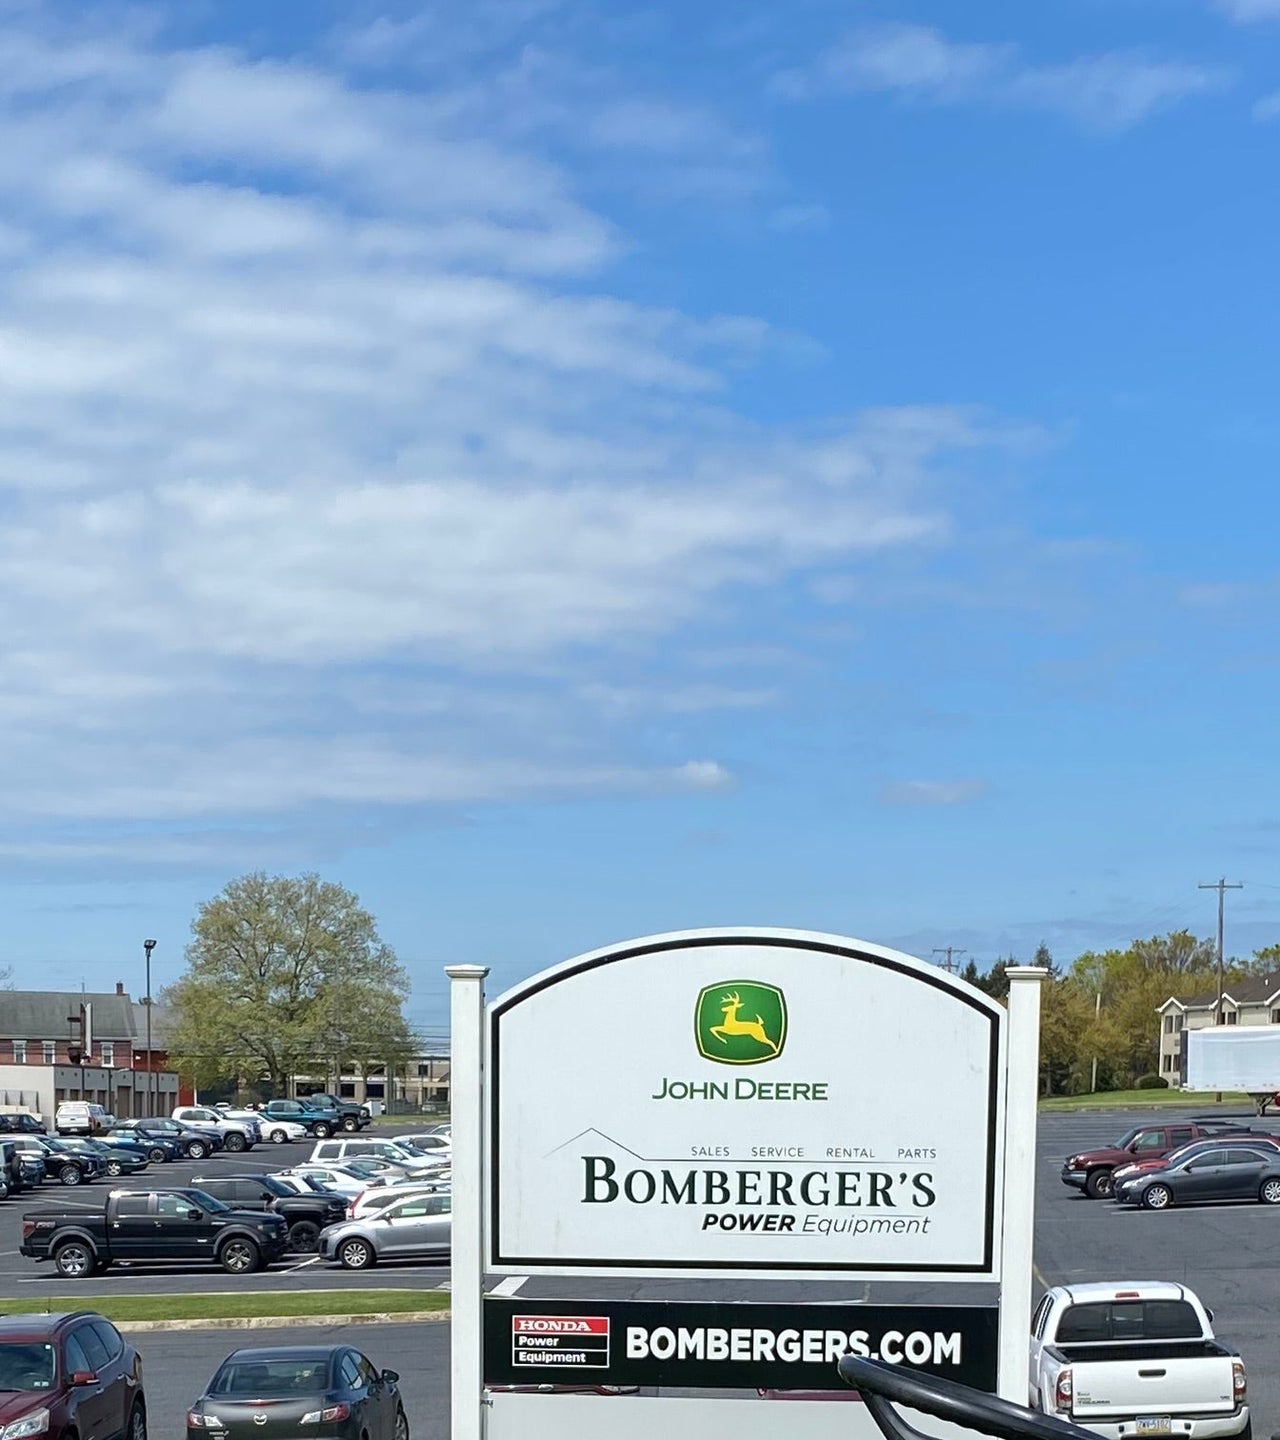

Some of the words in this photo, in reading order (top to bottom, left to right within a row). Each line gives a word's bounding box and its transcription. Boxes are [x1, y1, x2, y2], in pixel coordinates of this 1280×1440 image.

[652, 1078, 728, 1100] JOHN
[735, 1078, 828, 1101] DEERE
[691, 1146, 730, 1157] SALES
[751, 1146, 804, 1157] SERVICE
[826, 1147, 876, 1158] RENTAL
[898, 1148, 937, 1160] PARTS
[581, 1156, 937, 1208] BOMBERGER'S
[702, 1213, 796, 1232] POWER
[802, 1214, 931, 1237] Equipment
[519, 1320, 592, 1332] HONDA
[519, 1335, 560, 1347] Power
[626, 1327, 962, 1365] BOMBERGERS.COM
[519, 1351, 587, 1364] Equipment
